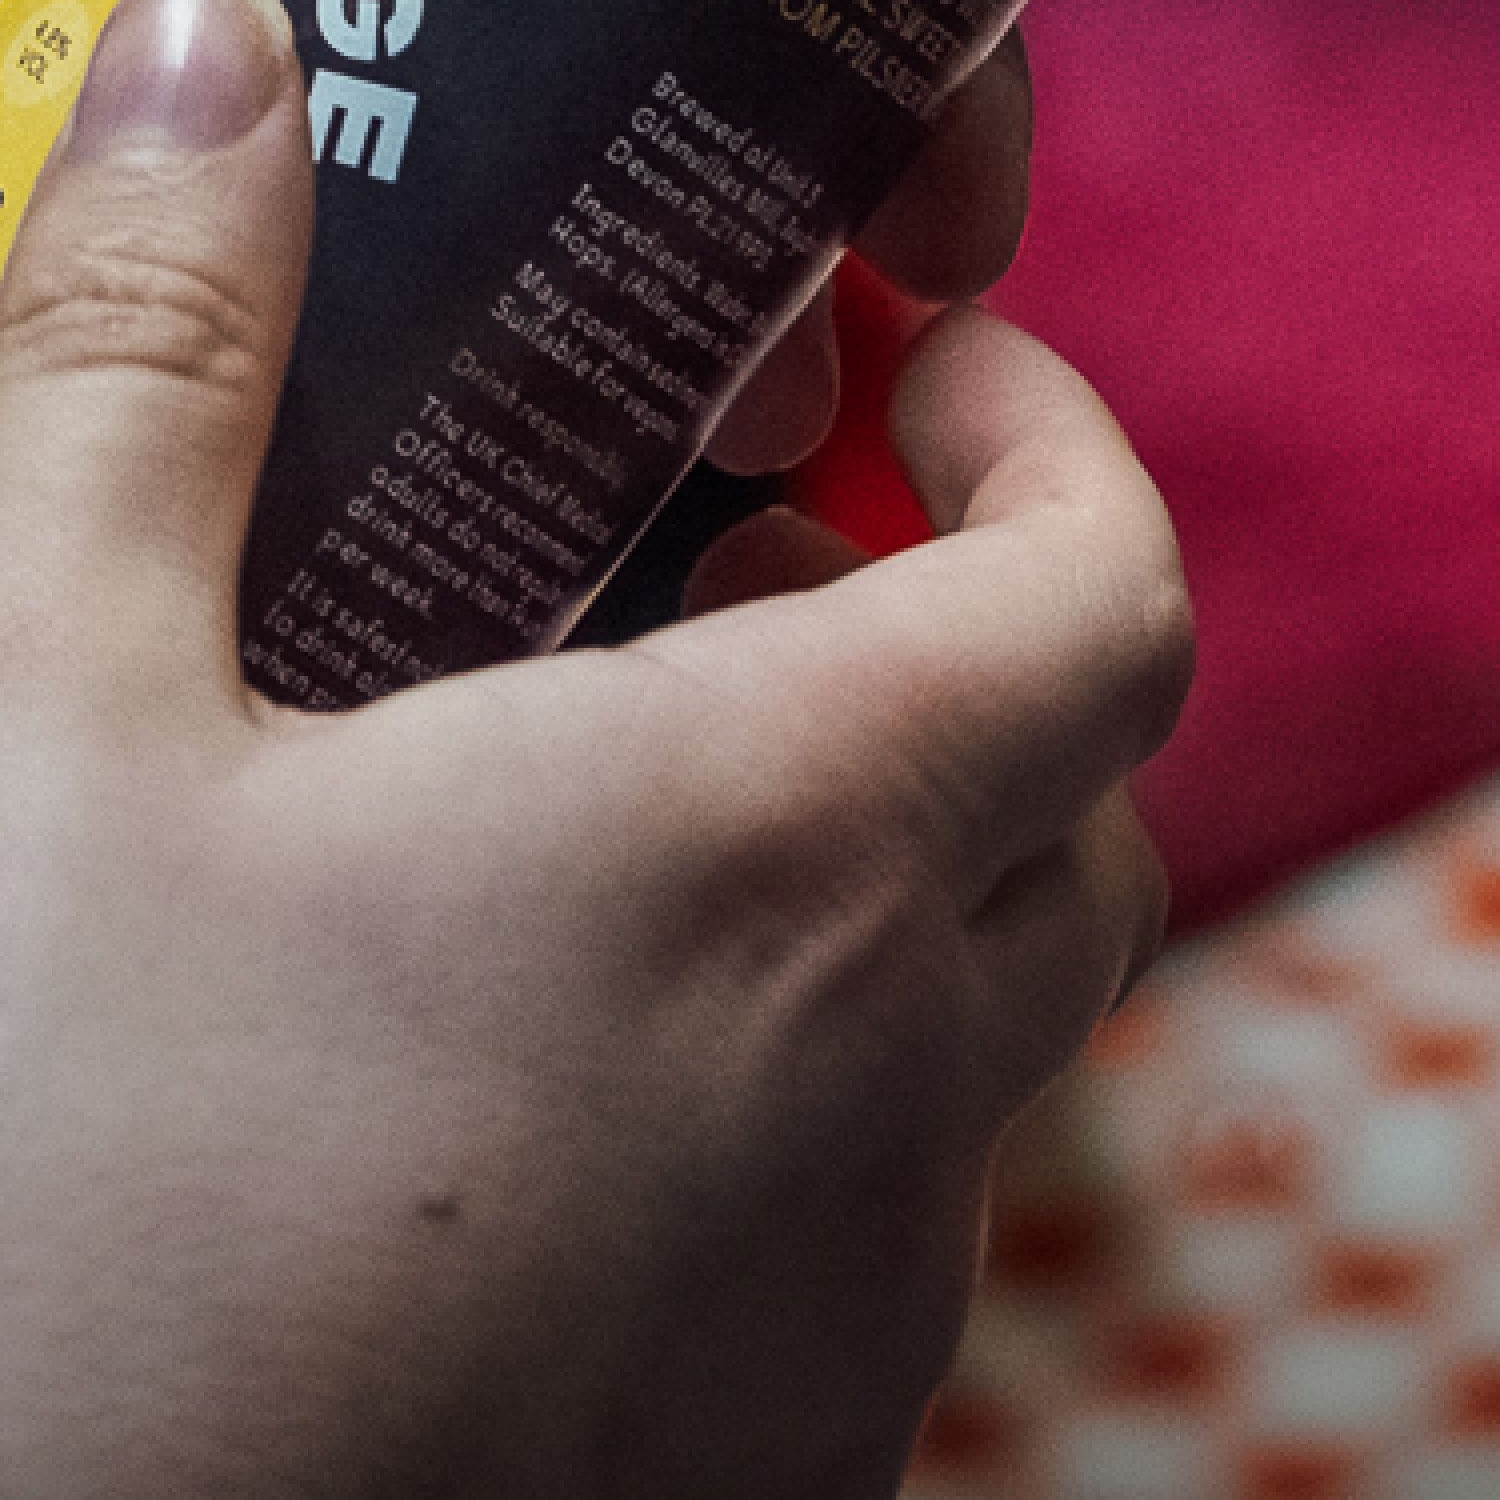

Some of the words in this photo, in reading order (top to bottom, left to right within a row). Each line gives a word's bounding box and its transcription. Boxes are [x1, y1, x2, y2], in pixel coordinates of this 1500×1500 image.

[17, 47, 46, 84] VOL
[651, 70, 753, 154] Brewed
[604, 136, 686, 208] Devon
[489, 292, 593, 379] Suitable
[590, 360, 628, 402] for
[514, 260, 571, 323] May
[569, 306, 651, 372] contain
[448, 346, 521, 410] Drink
[393, 428, 495, 514] Officers
[418, 392, 466, 443] The
[464, 429, 506, 470] UK
[500, 455, 567, 506] Chief
[315, 528, 372, 568] per
[345, 494, 413, 550] drink
[409, 541, 471, 592] more
[369, 464, 450, 530] adults
[446, 516, 482, 552] do
[262, 598, 296, 638] to
[294, 626, 359, 680] drink
[286, 568, 318, 602] It
[311, 594, 336, 618] is
[332, 607, 412, 667] safest
[243, 639, 311, 696] when
